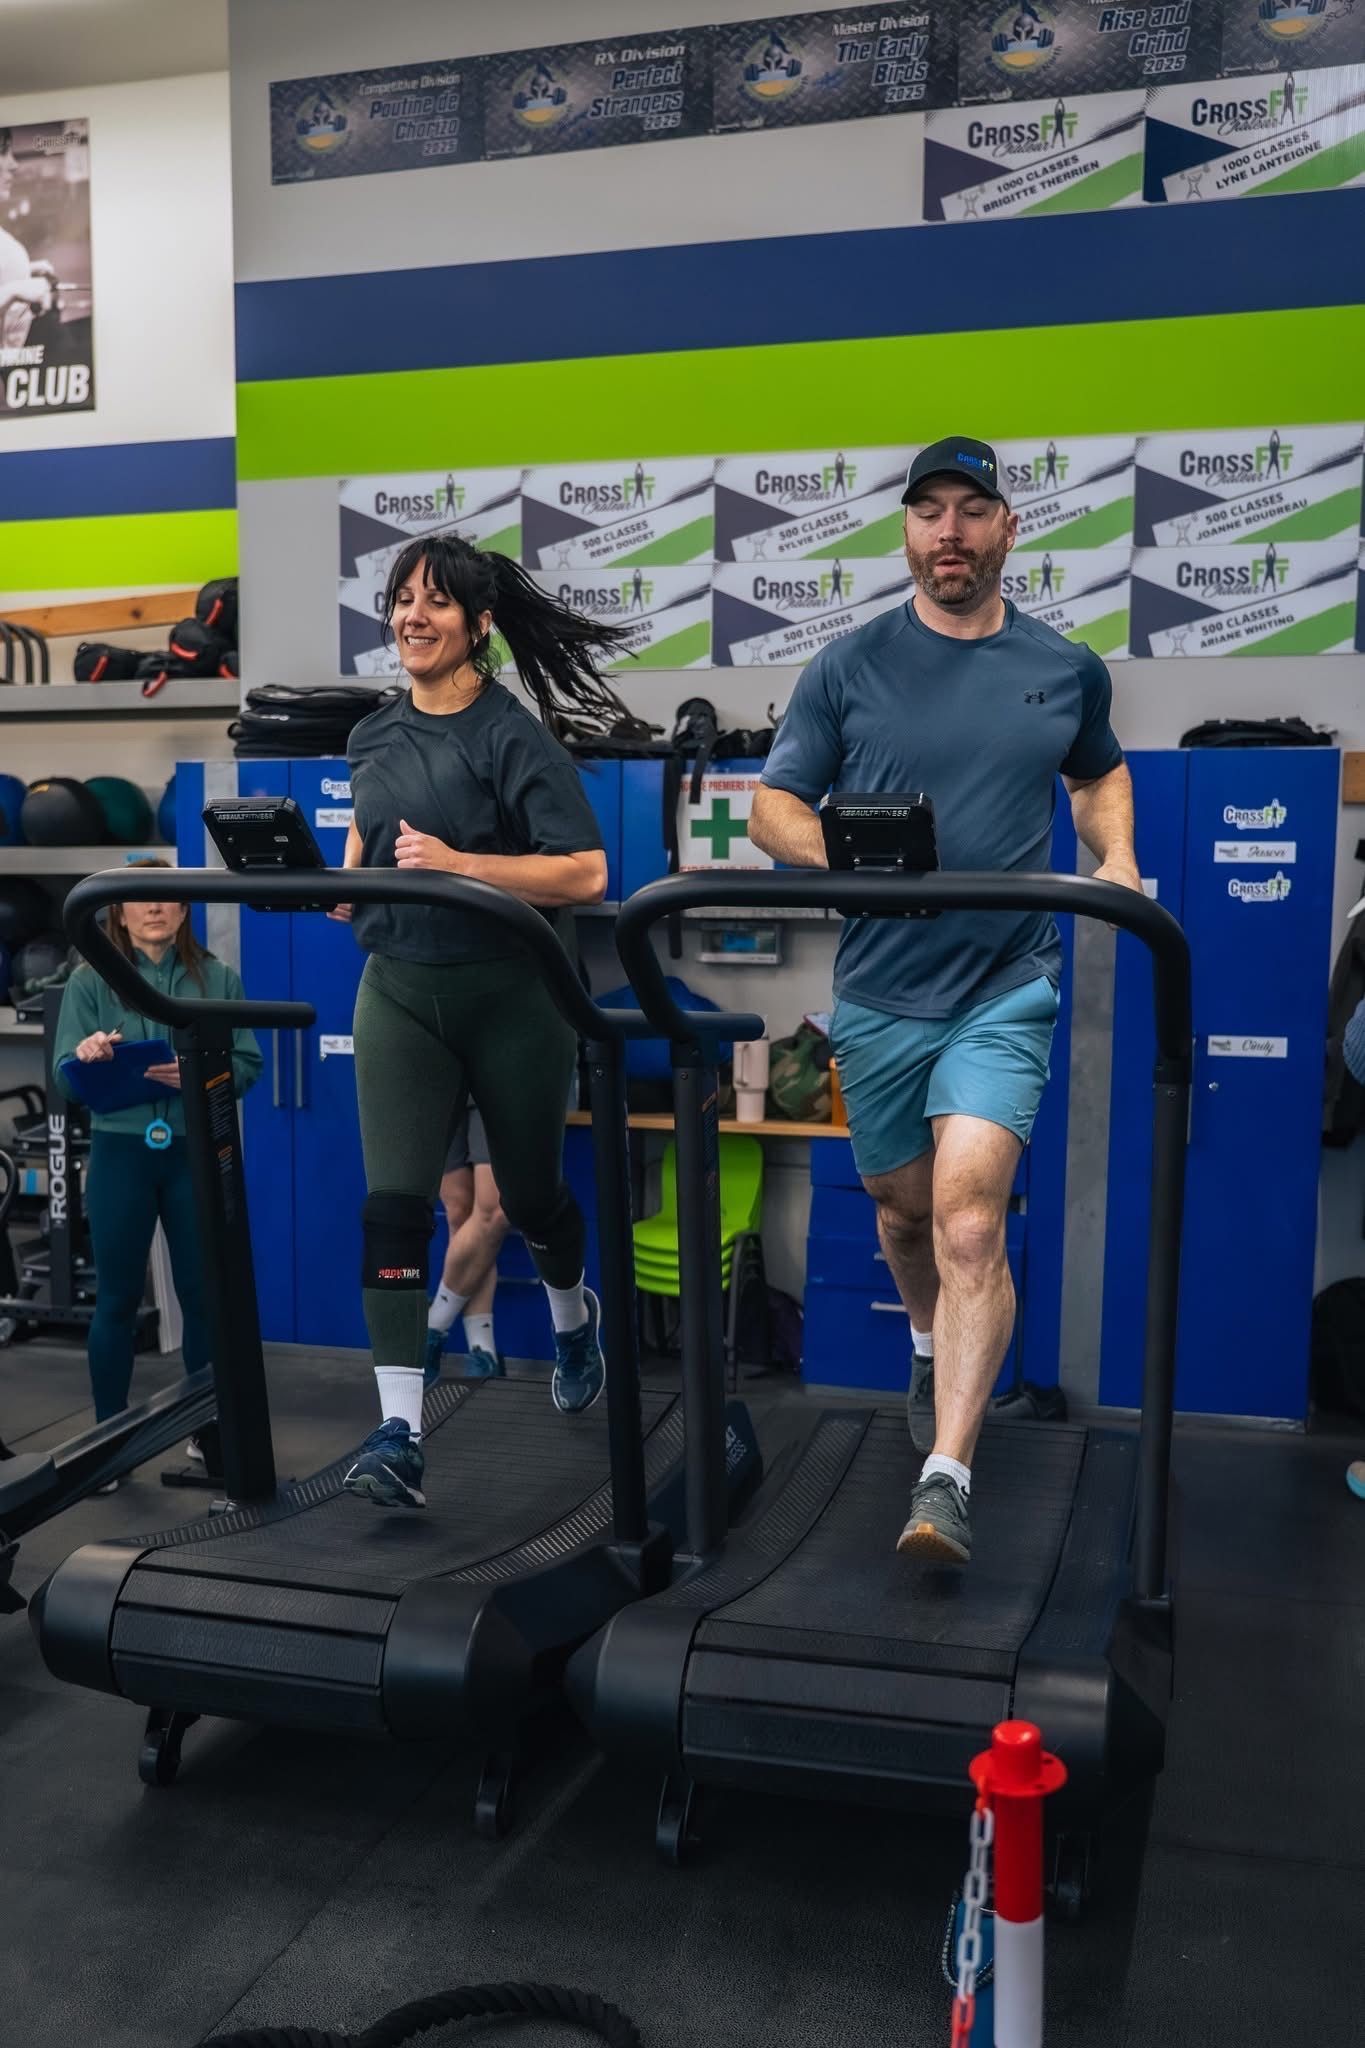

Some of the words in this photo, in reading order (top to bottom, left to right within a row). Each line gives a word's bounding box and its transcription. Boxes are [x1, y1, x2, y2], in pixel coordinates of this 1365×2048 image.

[833, 22, 877, 36] Master
[880, 15, 929, 31] Division
[1098, 8, 1146, 33] Rise
[1149, 0, 1191, 27] and
[594, 52, 616, 66] RX
[621, 45, 685, 63] Division
[835, 40, 873, 64] The
[874, 32, 929, 60] Early
[1128, 27, 1191, 57] Grind
[610, 60, 684, 92] Perfect
[871, 59, 929, 87] Birds
[1143, 55, 1187, 74] 2025
[369, 95, 434, 120] Poutine
[435, 89, 460, 114] de
[587, 91, 685, 119] Strangers
[884, 84, 926, 103] 2025
[1216, 170, 1248, 190] LYNE
[1250, 140, 1322, 176] LANTEIGNE
[1221, 155, 1250, 173] 1000
[1253, 131, 1310, 160] CLASSES
[983, 185, 1037, 212] BRIGITTE
[1040, 159, 1100, 189] THERRIEN
[997, 176, 1024, 193] 1000
[1026, 155, 1079, 179] CLASSES
[7, 363, 90, 408] CLUB
[1019, 502, 1061, 523] LASSES
[1037, 505, 1092, 529] LAPOINTE
[1197, 519, 1242, 541] JOANNE
[1244, 498, 1308, 526] BOUDREAU
[1205, 510, 1228, 525] 500
[1230, 492, 1284, 517] CLASSES
[582, 536, 601, 550] 500
[603, 520, 648, 542] CLASSES
[778, 535, 814, 553] SYLVIE
[816, 519, 864, 540] LEBLANC
[779, 527, 799, 541] 500
[801, 510, 849, 533] CLASSES
[590, 545, 615, 559] REMI
[615, 530, 655, 550] DOUCET
[783, 630, 803, 643] 500
[806, 613, 853, 636] CLASSES
[1200, 630, 1242, 649] ARIANE
[1244, 614, 1294, 635] WHITING
[1202, 620, 1223, 636] 500
[1226, 605, 1279, 629] CLASSES
[768, 638, 815, 661] BRIGITTE
[709, 780, 745, 792] PREMIERS
[50, 1113, 66, 1219] ROGUE
